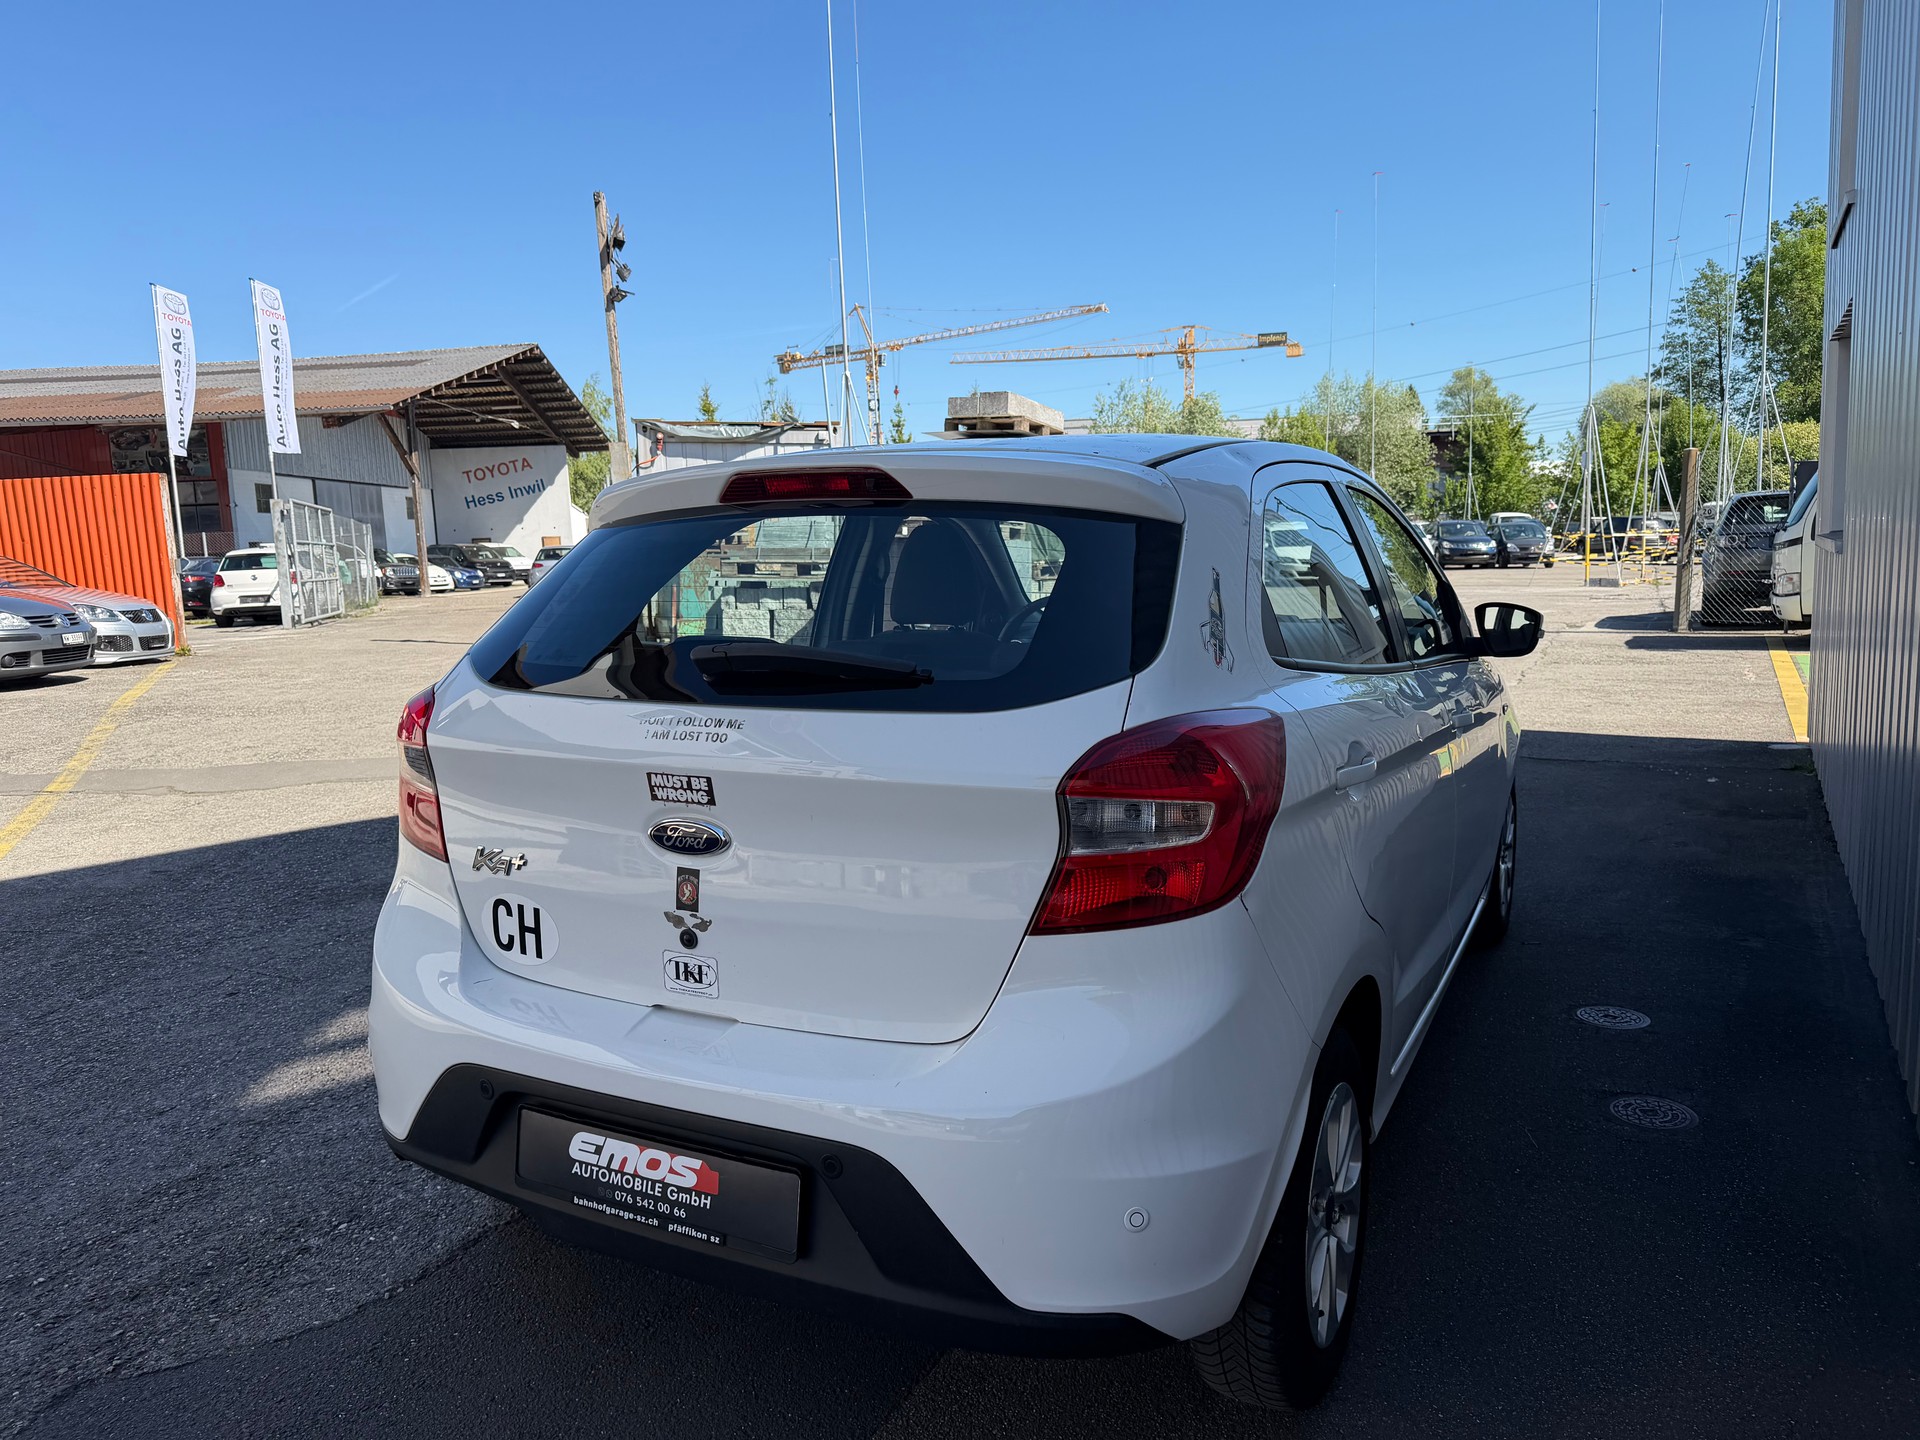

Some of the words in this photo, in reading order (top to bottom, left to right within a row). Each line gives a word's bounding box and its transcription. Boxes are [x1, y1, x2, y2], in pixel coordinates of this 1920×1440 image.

[162, 312, 192, 326] TOYOTA
[260, 308, 286, 322] TOYOTA
[171, 328, 182, 354] AG
[269, 324, 279, 350] AG
[462, 457, 533, 484] TOYOTA
[464, 492, 504, 509] Hess
[508, 478, 546, 499] Inwil
[676, 716, 725, 728] FOLLOW
[726, 719, 746, 730] ME
[651, 730, 671, 740] AM
[672, 730, 702, 742] LOST
[705, 732, 728, 743] TOO
[650, 774, 688, 789] MUST
[690, 777, 708, 790] BE
[653, 787, 710, 803] WRONG
[663, 824, 708, 850] Ford
[492, 898, 543, 959] CH
[572, 1162, 662, 1197] AUTOMOBILE
[667, 1186, 711, 1209] GmbH
[615, 1191, 633, 1204] 076
[636, 1197, 655, 1210] 542
[658, 1202, 670, 1214] 00
[674, 1206, 686, 1218] 66
[574, 1196, 659, 1227] bahnhofgarage-sz.ch
[668, 1223, 707, 1241] pfäffikon
[710, 1235, 720, 1244] sz
